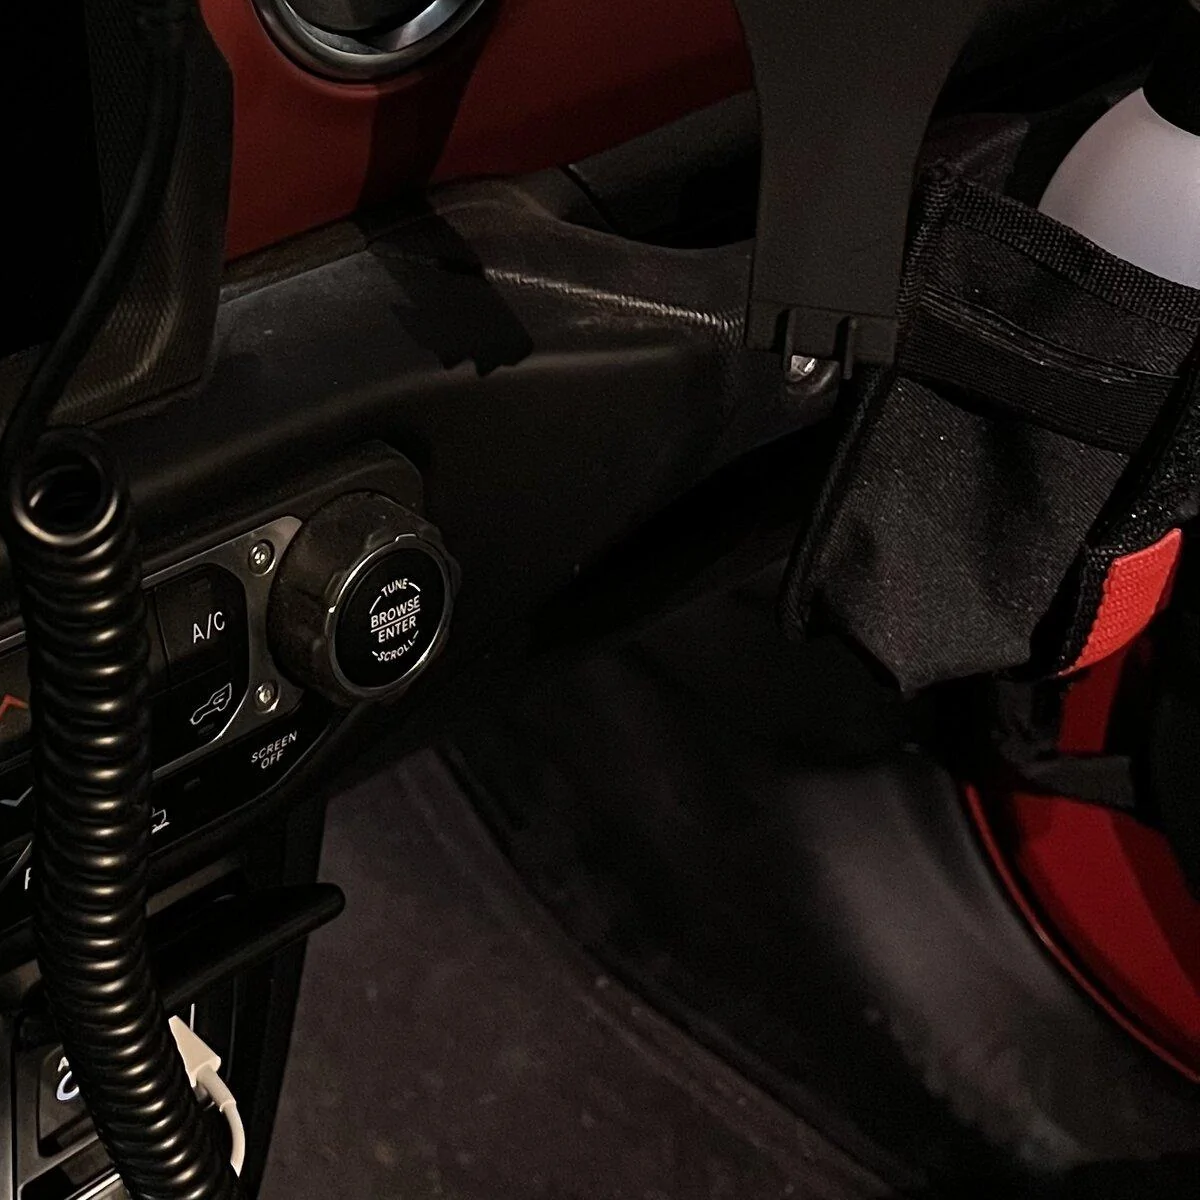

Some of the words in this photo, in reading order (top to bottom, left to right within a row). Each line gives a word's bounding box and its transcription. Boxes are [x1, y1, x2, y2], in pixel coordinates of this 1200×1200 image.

[381, 578, 409, 598] TUNE
[370, 596, 421, 629] BROWSE
[191, 611, 226, 644] A/C
[377, 615, 417, 643] ENTER
[377, 638, 414, 663] SCROLL
[251, 730, 298, 763] SCREEN
[260, 750, 284, 770] OFF
